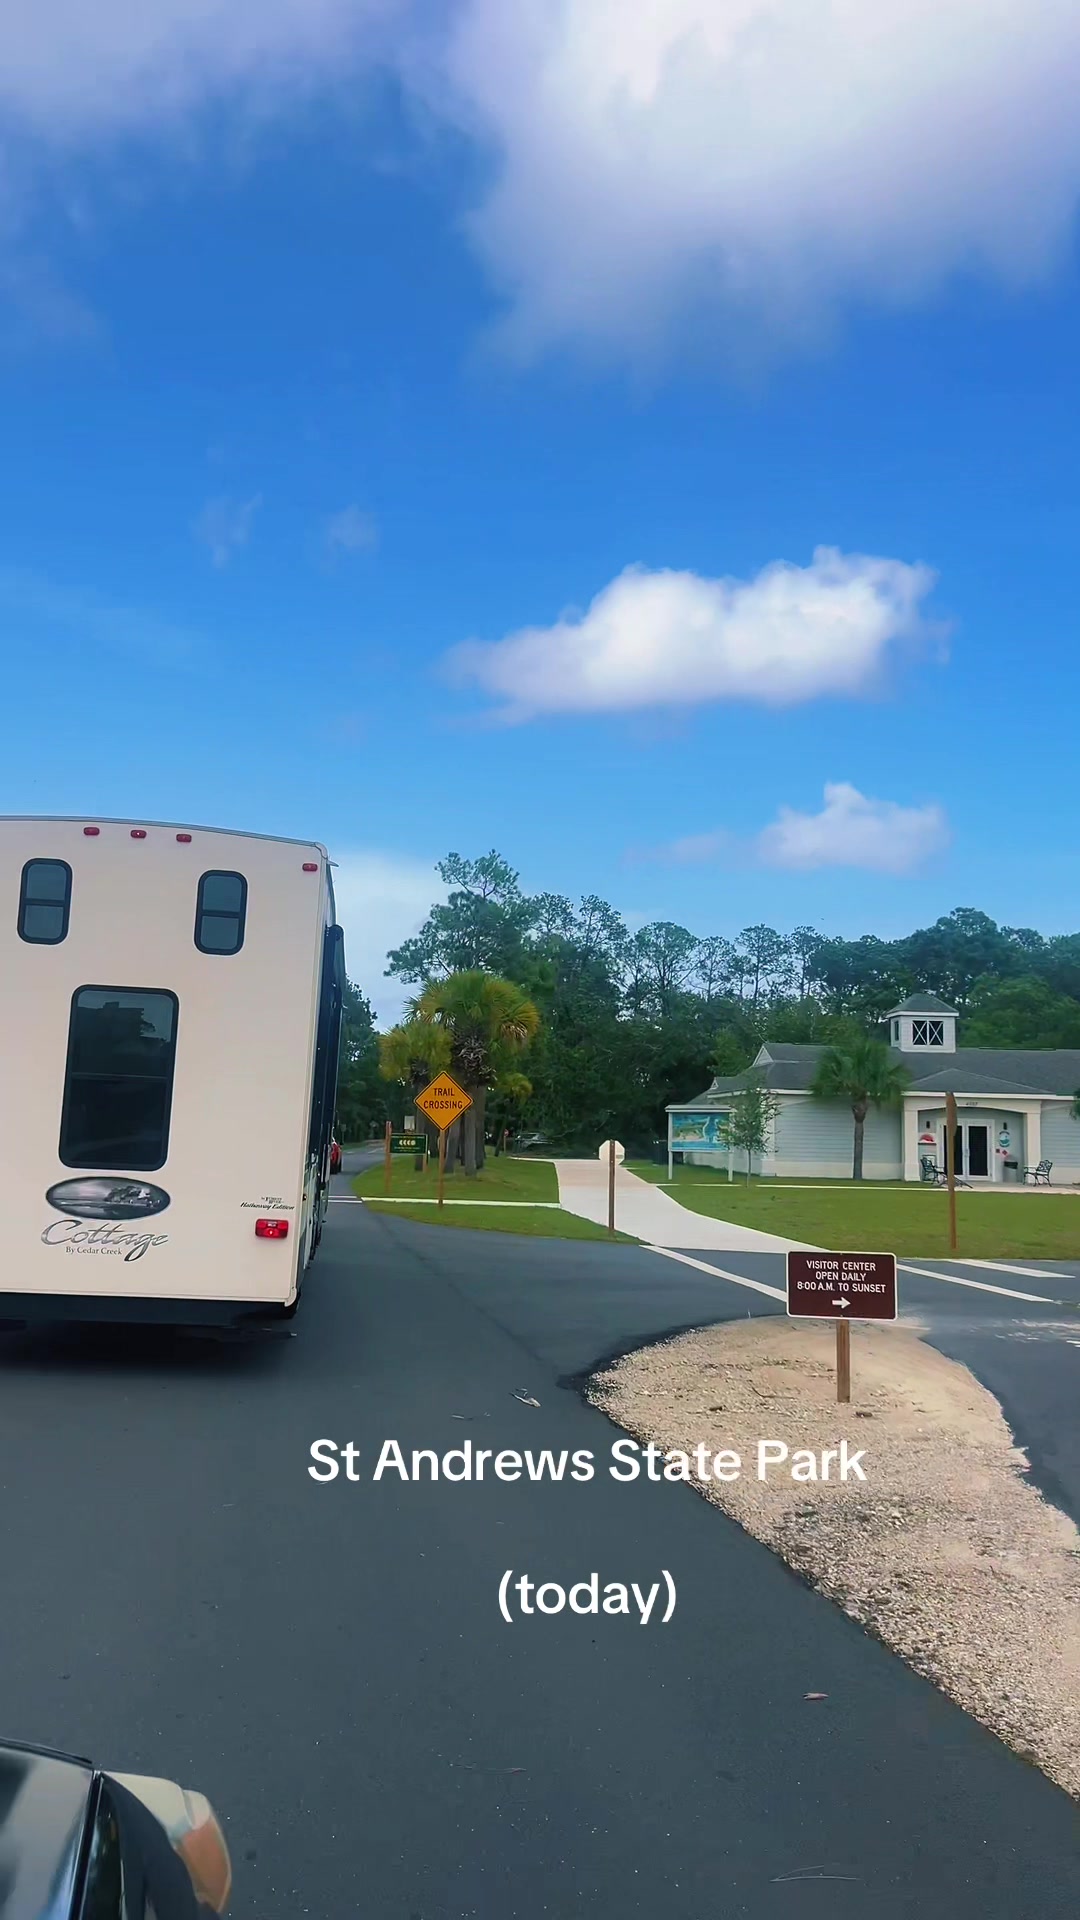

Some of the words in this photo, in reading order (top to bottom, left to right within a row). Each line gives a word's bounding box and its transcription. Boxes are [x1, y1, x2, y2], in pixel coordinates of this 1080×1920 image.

[433, 1087, 455, 1096] TRAIL
[423, 1100, 463, 1109] CROSSING
[40, 1219, 169, 1262] Cottage
[65, 1246, 75, 1256] By
[77, 1246, 99, 1254] Cedar
[100, 1247, 122, 1255] Creek
[806, 1260, 839, 1270] VISITOR
[842, 1261, 876, 1271] CENTER
[815, 1271, 839, 1281] OPEN
[841, 1272, 866, 1281] DAILY
[796, 1281, 817, 1290] 8:00
[838, 1282, 849, 1292] TO
[852, 1283, 886, 1293] SUNSET
